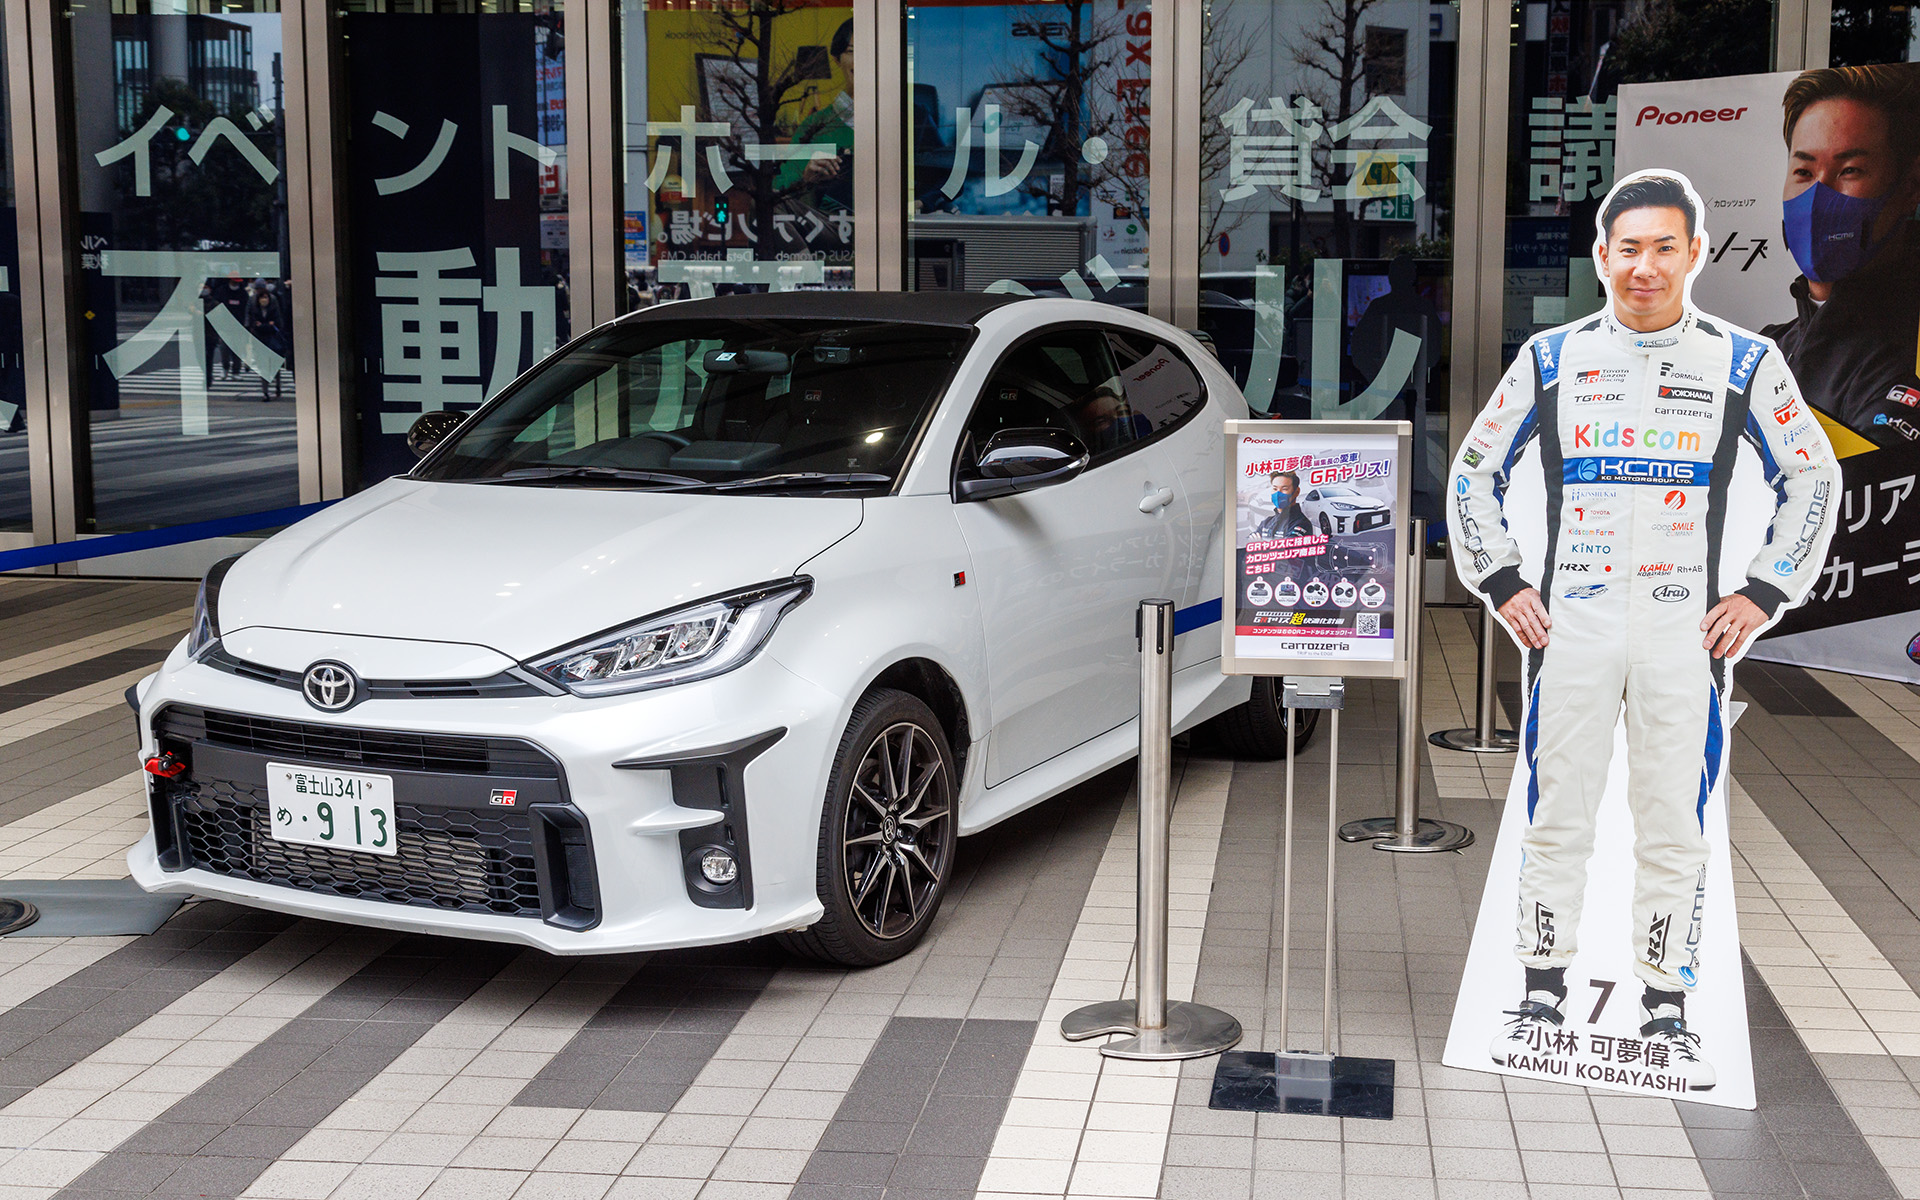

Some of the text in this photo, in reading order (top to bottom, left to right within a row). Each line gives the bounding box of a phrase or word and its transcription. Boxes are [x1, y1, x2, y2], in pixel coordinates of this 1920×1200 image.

[1635, 105, 1748, 127] Pioneer
[1713, 198, 1756, 208] カロッツェリア
[1538, 338, 1555, 369] HRX
[1736, 342, 1762, 379] HRX
[1670, 372, 1704, 382] FORMULA
[1671, 389, 1712, 401] YOKOHAMA
[1890, 388, 1918, 406] GR
[1655, 407, 1713, 419] carrozzeria
[1243, 436, 1284, 444] Pioneer
[1601, 459, 1695, 478] KCMG
[1672, 522, 1695, 531] SMILE
[1786, 480, 1826, 562] KCMG
[1559, 562, 1591, 572] HRX
[1639, 563, 1703, 574] KAMUI Rh+AB
[1656, 585, 1685, 599] Arai
[1281, 642, 1350, 651] carrozzeria
[1587, 979, 1617, 1024] 7
[1526, 1026, 1671, 1069] 小林 可夢偉
[1507, 1053, 1687, 1093] KAMUI KOBAYASHI
